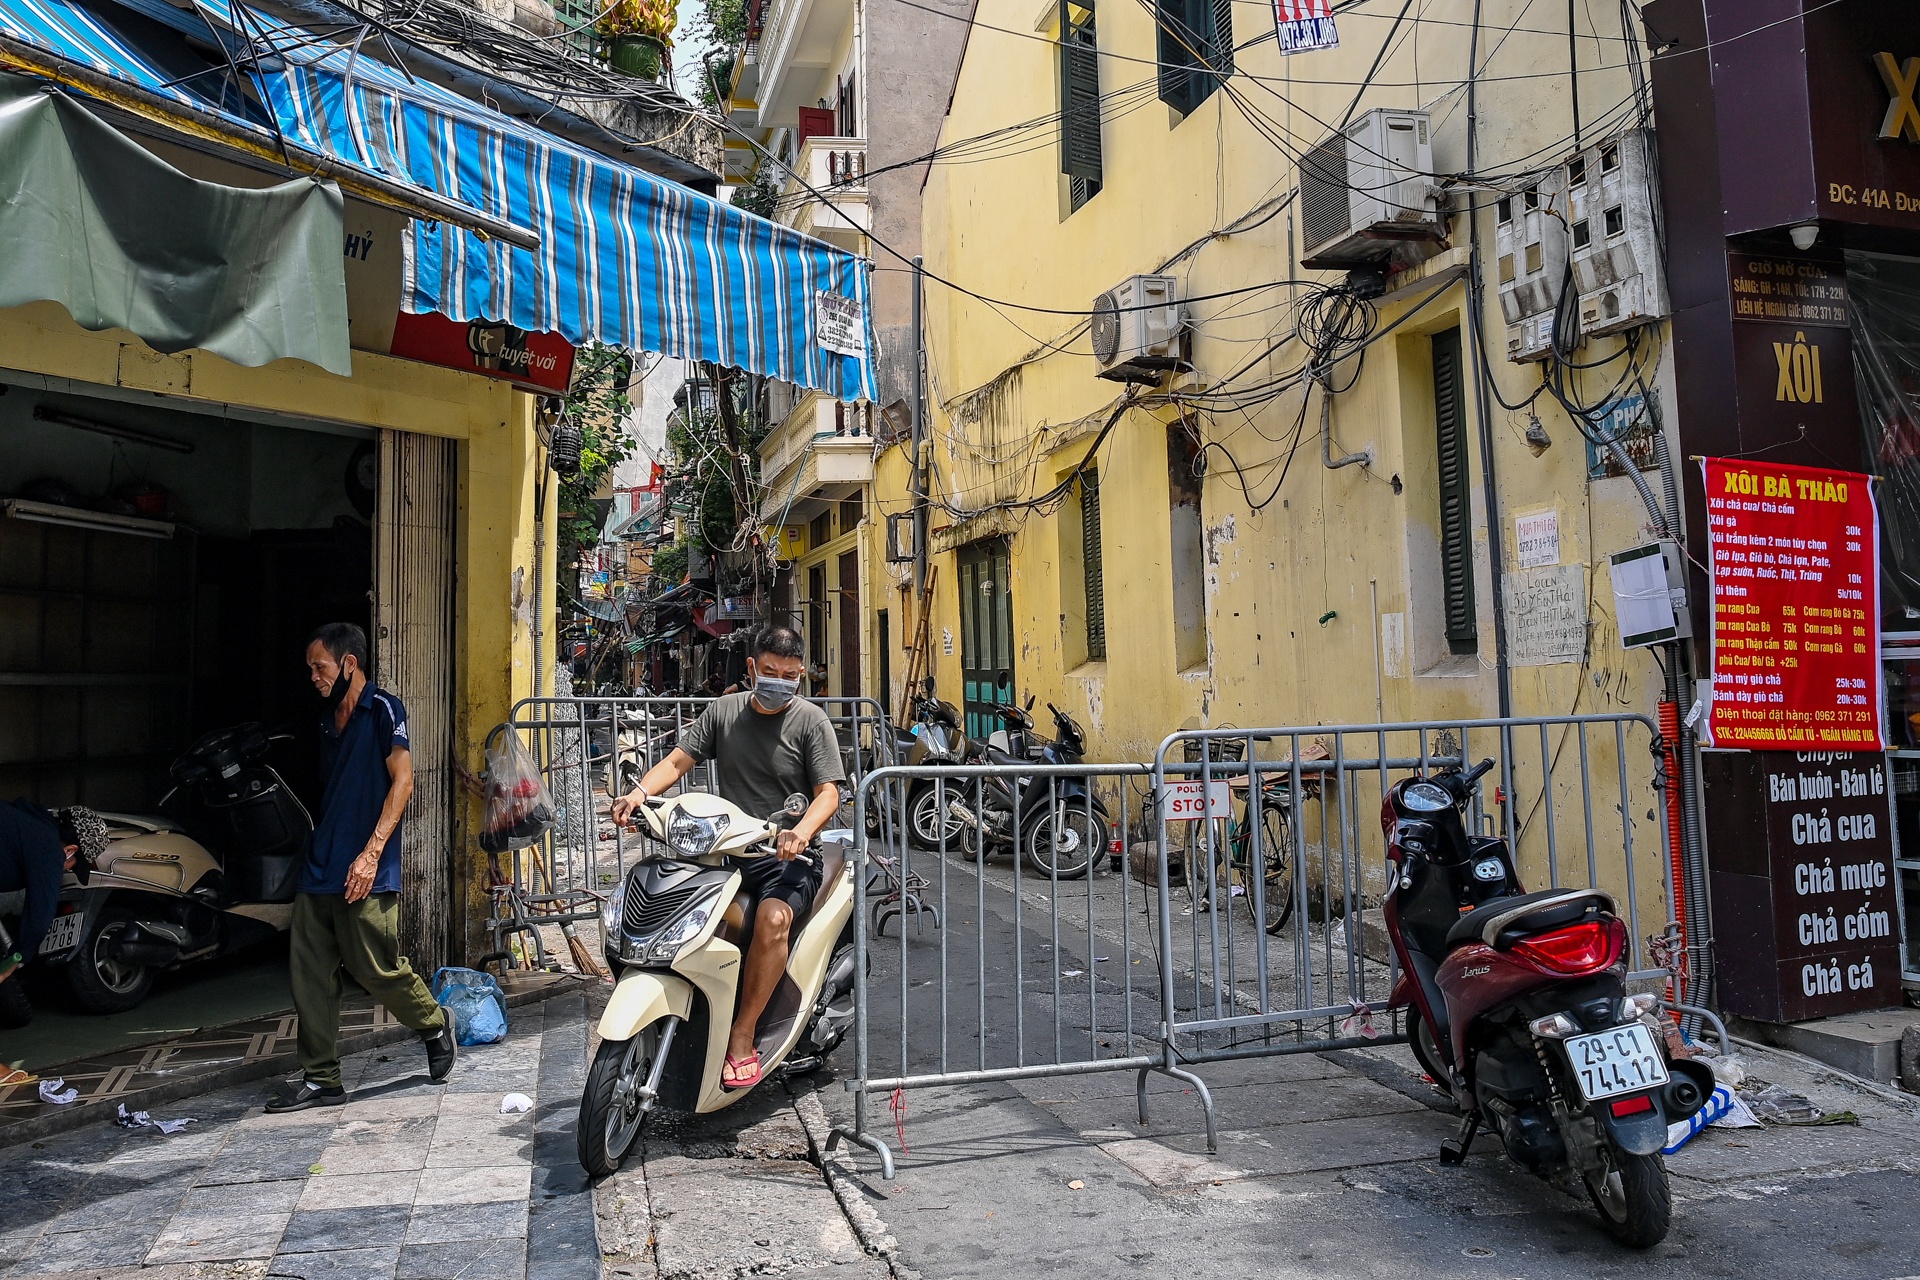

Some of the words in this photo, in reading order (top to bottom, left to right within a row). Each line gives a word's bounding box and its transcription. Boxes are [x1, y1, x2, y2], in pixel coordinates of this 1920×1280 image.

[1829, 183, 1857, 205] ĐC:
[1862, 188, 1891, 209] 41A
[1895, 191, 1920, 211] Đư
[344, 230, 373, 261] HỶ
[1734, 277, 1759, 293] SÁNG:
[1760, 283, 1771, 295] 6H
[1794, 280, 1809, 297] TỐI:
[1737, 298, 1752, 314] LIÊN
[1755, 299, 1764, 318] HỆ
[1766, 300, 1786, 317] NGOÀI
[1788, 301, 1801, 317] GIỜ:
[1803, 305, 1819, 319] 0962
[1821, 307, 1832, 320] 371
[1834, 307, 1845, 321] 291
[499, 344, 535, 367] tuyệt
[536, 353, 557, 370] vời
[1773, 331, 1822, 403] XÔI
[1725, 470, 1758, 495] XÔI
[1764, 474, 1791, 498] BÀ
[1796, 477, 1847, 503] THẢO
[1710, 498, 1724, 509] Xôi
[1727, 499, 1741, 509] chả
[1743, 501, 1760, 511] cua/
[1762, 502, 1776, 513] Chả
[1778, 503, 1794, 514] cốm
[1710, 515, 1724, 525] Xôi
[1727, 516, 1736, 527] gà
[1846, 526, 1861, 536] 30k
[1726, 531, 1747, 545] trắng
[1750, 536, 1766, 546] kèm
[1768, 538, 1773, 546] 2
[1776, 538, 1790, 547] món
[1808, 539, 1827, 551] chọn
[1847, 542, 1861, 551] 30k
[1716, 550, 1728, 561] Giò
[1750, 553, 1762, 563] Giò
[1778, 554, 1792, 565] Chả
[1716, 565, 1730, 577] Lạp
[1800, 571, 1822, 582] Trứng
[1848, 574, 1861, 583] 10k
[1715, 586, 1724, 595] ôi
[1726, 586, 1747, 596] thêm
[1838, 589, 1862, 600] 5k/10k
[1715, 605, 1726, 613] ơm
[1728, 605, 1744, 614] rang
[1746, 604, 1760, 614] Cua
[1783, 606, 1796, 616] 65k
[1804, 606, 1819, 616] Cơm
[1821, 609, 1832, 618] rang
[1834, 608, 1841, 618] Bò
[1843, 608, 1851, 619] Gà
[1853, 610, 1865, 620] 75k
[1715, 622, 1726, 631] ơm
[1728, 623, 1744, 632] rang
[1746, 621, 1759, 631] Cua
[1761, 622, 1770, 632] Bò
[1783, 623, 1797, 633] 75k
[1804, 623, 1819, 634] Cơm
[1821, 626, 1832, 635] rang
[1834, 625, 1842, 635] Bò
[1853, 627, 1865, 636] 60k
[1715, 639, 1726, 648] ơm
[1728, 640, 1744, 649] rang
[1746, 639, 1762, 651] Thập
[1765, 637, 1779, 649] cẩm
[1784, 640, 1797, 650] 50k
[1805, 641, 1819, 651] Cơm
[1820, 643, 1833, 653] rang
[1835, 642, 1843, 652] Gà
[1854, 644, 1866, 653] 60k
[1720, 654, 1732, 666] phủ
[1734, 656, 1750, 666] Cua/
[1766, 656, 1775, 667] Gà
[1780, 657, 1797, 667] +25k
[1714, 673, 1733, 684] Bánh
[1751, 674, 1763, 685] giò
[1766, 673, 1781, 685] chả
[1836, 678, 1866, 688] 25k-30k
[1714, 690, 1734, 701] Bánh
[1754, 691, 1766, 703] giò
[1769, 691, 1783, 702] chả
[1837, 695, 1867, 705] 20k-30k
[1716, 708, 1739, 720] Điện
[1743, 708, 1766, 722] thoại
[1769, 710, 1783, 723] đặt
[1786, 710, 1812, 723] hàng:
[1815, 711, 1835, 721] 0962
[1838, 711, 1852, 721] 371
[1856, 712, 1871, 722] 291
[1716, 727, 1733, 739] STK:
[1805, 726, 1814, 741] TÚ
[1842, 727, 1861, 741] HÀNG
[1863, 729, 1874, 742] VIB
[1770, 773, 1796, 802] Bán
[1799, 770, 1832, 800] buôn
[1841, 767, 1867, 797] Bán
[1870, 764, 1884, 795] lẻ
[1792, 808, 1831, 845] Chả
[1837, 813, 1876, 842] cua
[1795, 857, 1835, 895] Chả
[1841, 859, 1886, 895] mực
[1798, 906, 1838, 946] Chả
[1844, 902, 1890, 940] cốm
[46, 931, 73, 951] 1708
[1802, 958, 1842, 997] Chả
[1848, 955, 1874, 991] cá
[1578, 1029, 1642, 1065] 29-C1
[1582, 1056, 1662, 1095] 744.12
